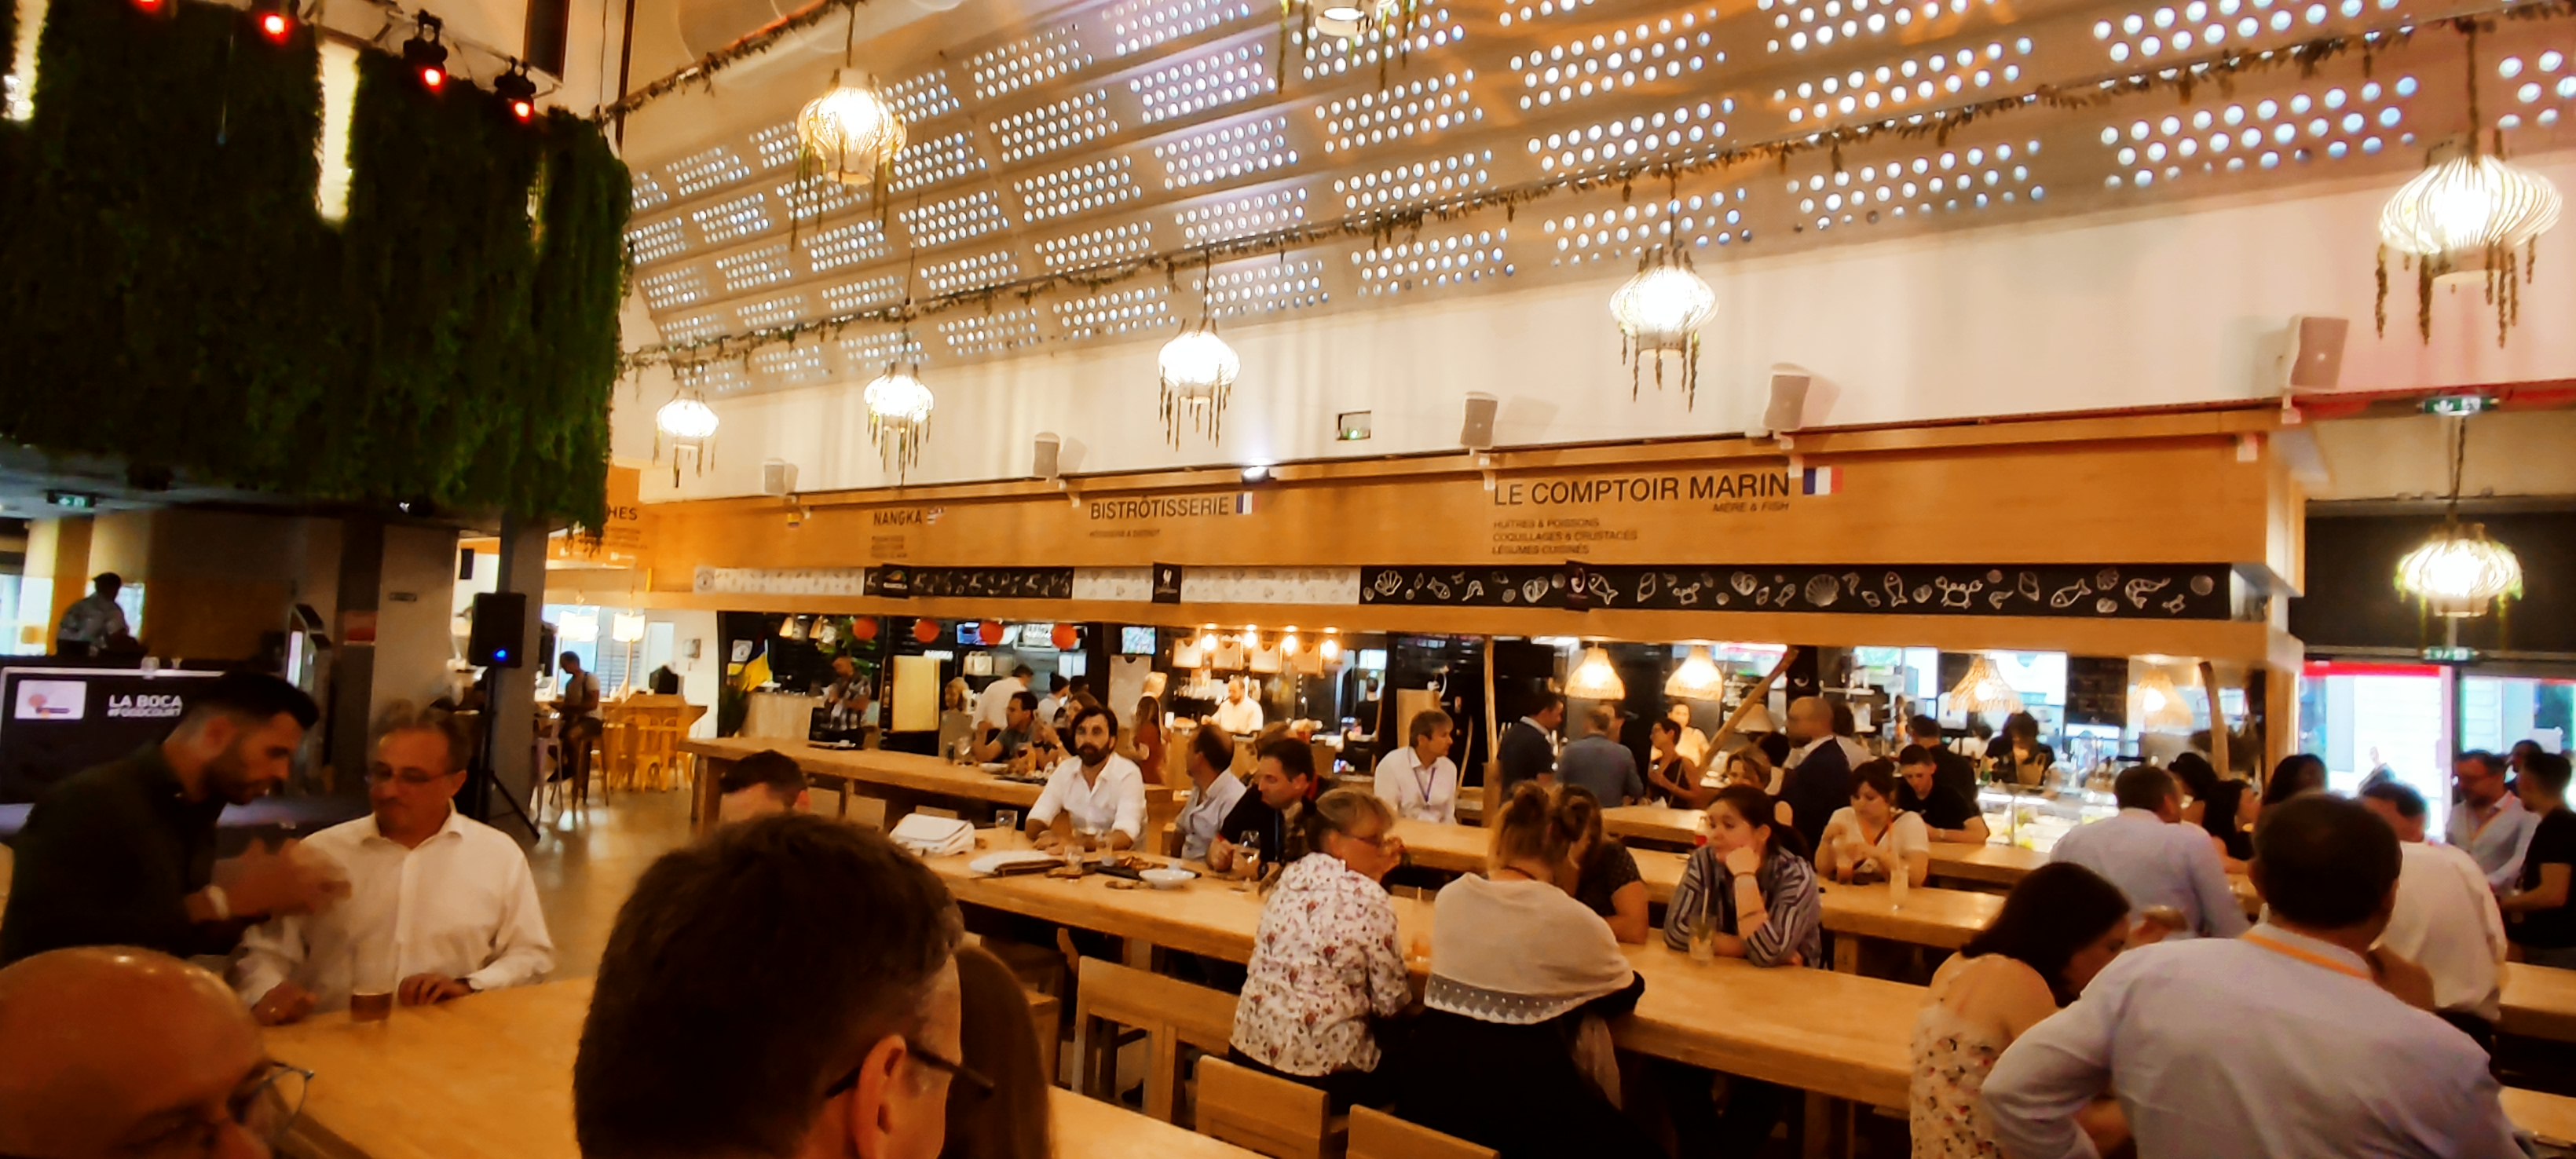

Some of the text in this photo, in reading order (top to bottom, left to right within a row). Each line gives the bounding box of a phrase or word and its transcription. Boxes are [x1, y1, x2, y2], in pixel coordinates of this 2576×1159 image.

[1495, 472, 1789, 506] LE COMPTOIR MARIN
[873, 510, 923, 526] NANGKA
[1493, 531, 1562, 542] COQUILLAGES
[109, 694, 183, 707] LA BOCA
